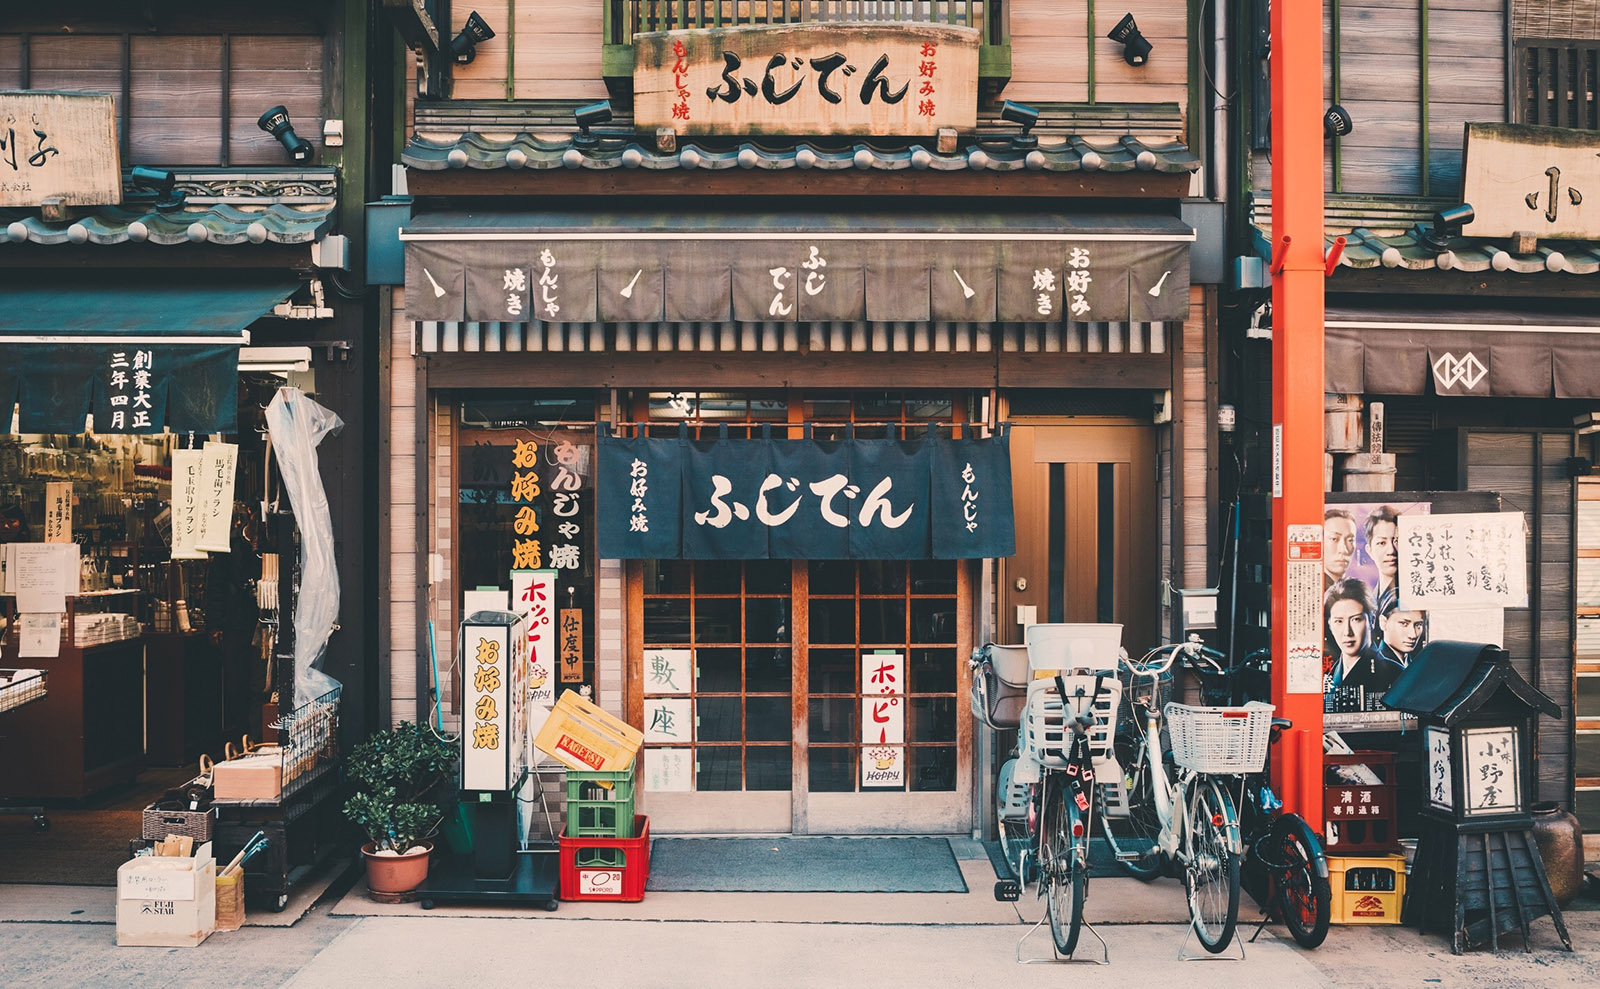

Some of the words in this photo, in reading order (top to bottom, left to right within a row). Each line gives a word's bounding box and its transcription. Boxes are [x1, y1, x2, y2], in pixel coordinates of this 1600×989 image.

[671, 40, 691, 120] もんじゃ焼
[707, 50, 909, 105] ふじでん
[918, 41, 937, 117] お好み焼
[503, 269, 527, 315] 焼き
[539, 248, 560, 316] もんじゃ
[770, 268, 793, 316] でん
[802, 246, 827, 296] ふじ
[1032, 269, 1056, 315] 焼き
[1067, 247, 1092, 316] お好み
[109, 352, 130, 430] 三年四月
[131, 350, 153, 428] 創業大正
[512, 438, 541, 571] お好み焼
[549, 440, 581, 570] もんじゃ焼
[629, 457, 649, 533] お好み焼
[694, 473, 914, 529] ふじでん
[961, 463, 979, 534] もんじゃ
[521, 578, 549, 663] ホッピー
[563, 614, 580, 670] 仕度中
[472, 637, 500, 751] お好み焼
[650, 655, 680, 691] 敷
[869, 659, 899, 745] ホッピー
[560, 736, 604, 767] KAGETSU
[649, 705, 678, 738] 座
[866, 771, 900, 780] HOPPY
[1341, 791, 1371, 804] 清酒
[1433, 739, 1446, 801] 小野屋
[1479, 741, 1504, 808] 小野屋
[612, 873, 621, 881] 20
